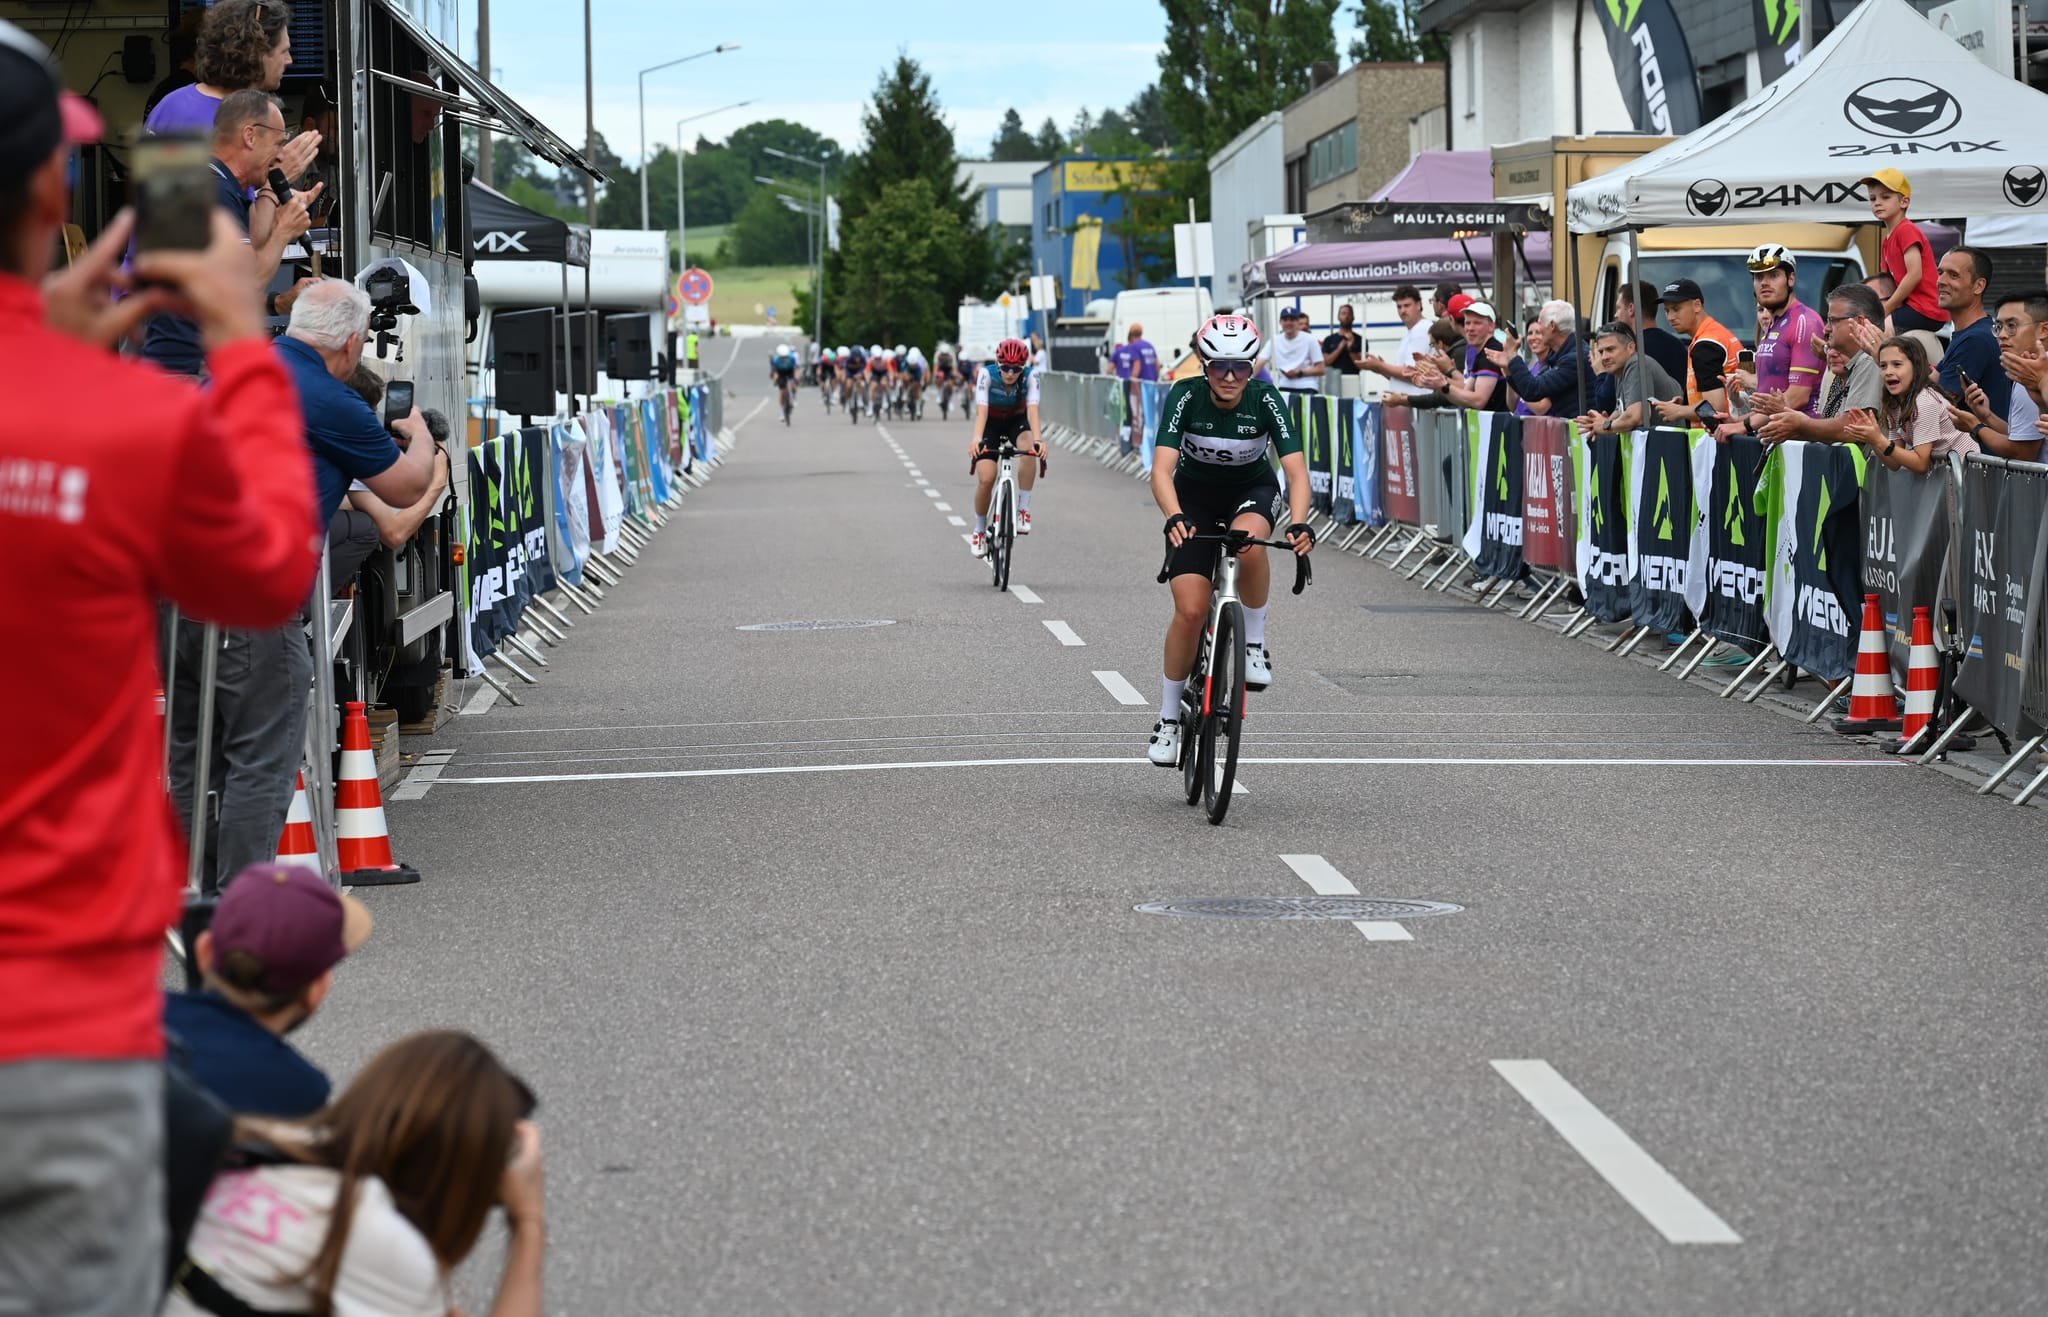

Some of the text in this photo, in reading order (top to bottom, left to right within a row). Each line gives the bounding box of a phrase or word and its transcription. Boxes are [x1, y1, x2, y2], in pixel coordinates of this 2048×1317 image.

[1828, 140, 2008, 157] 24MX
[1734, 182, 1869, 209] 24MX
[1393, 213, 1506, 225] MAULTASCHEN
[1171, 390, 1193, 426] CUORE
[1267, 402, 1290, 440] CUORE
[1184, 437, 1234, 463] RTS
